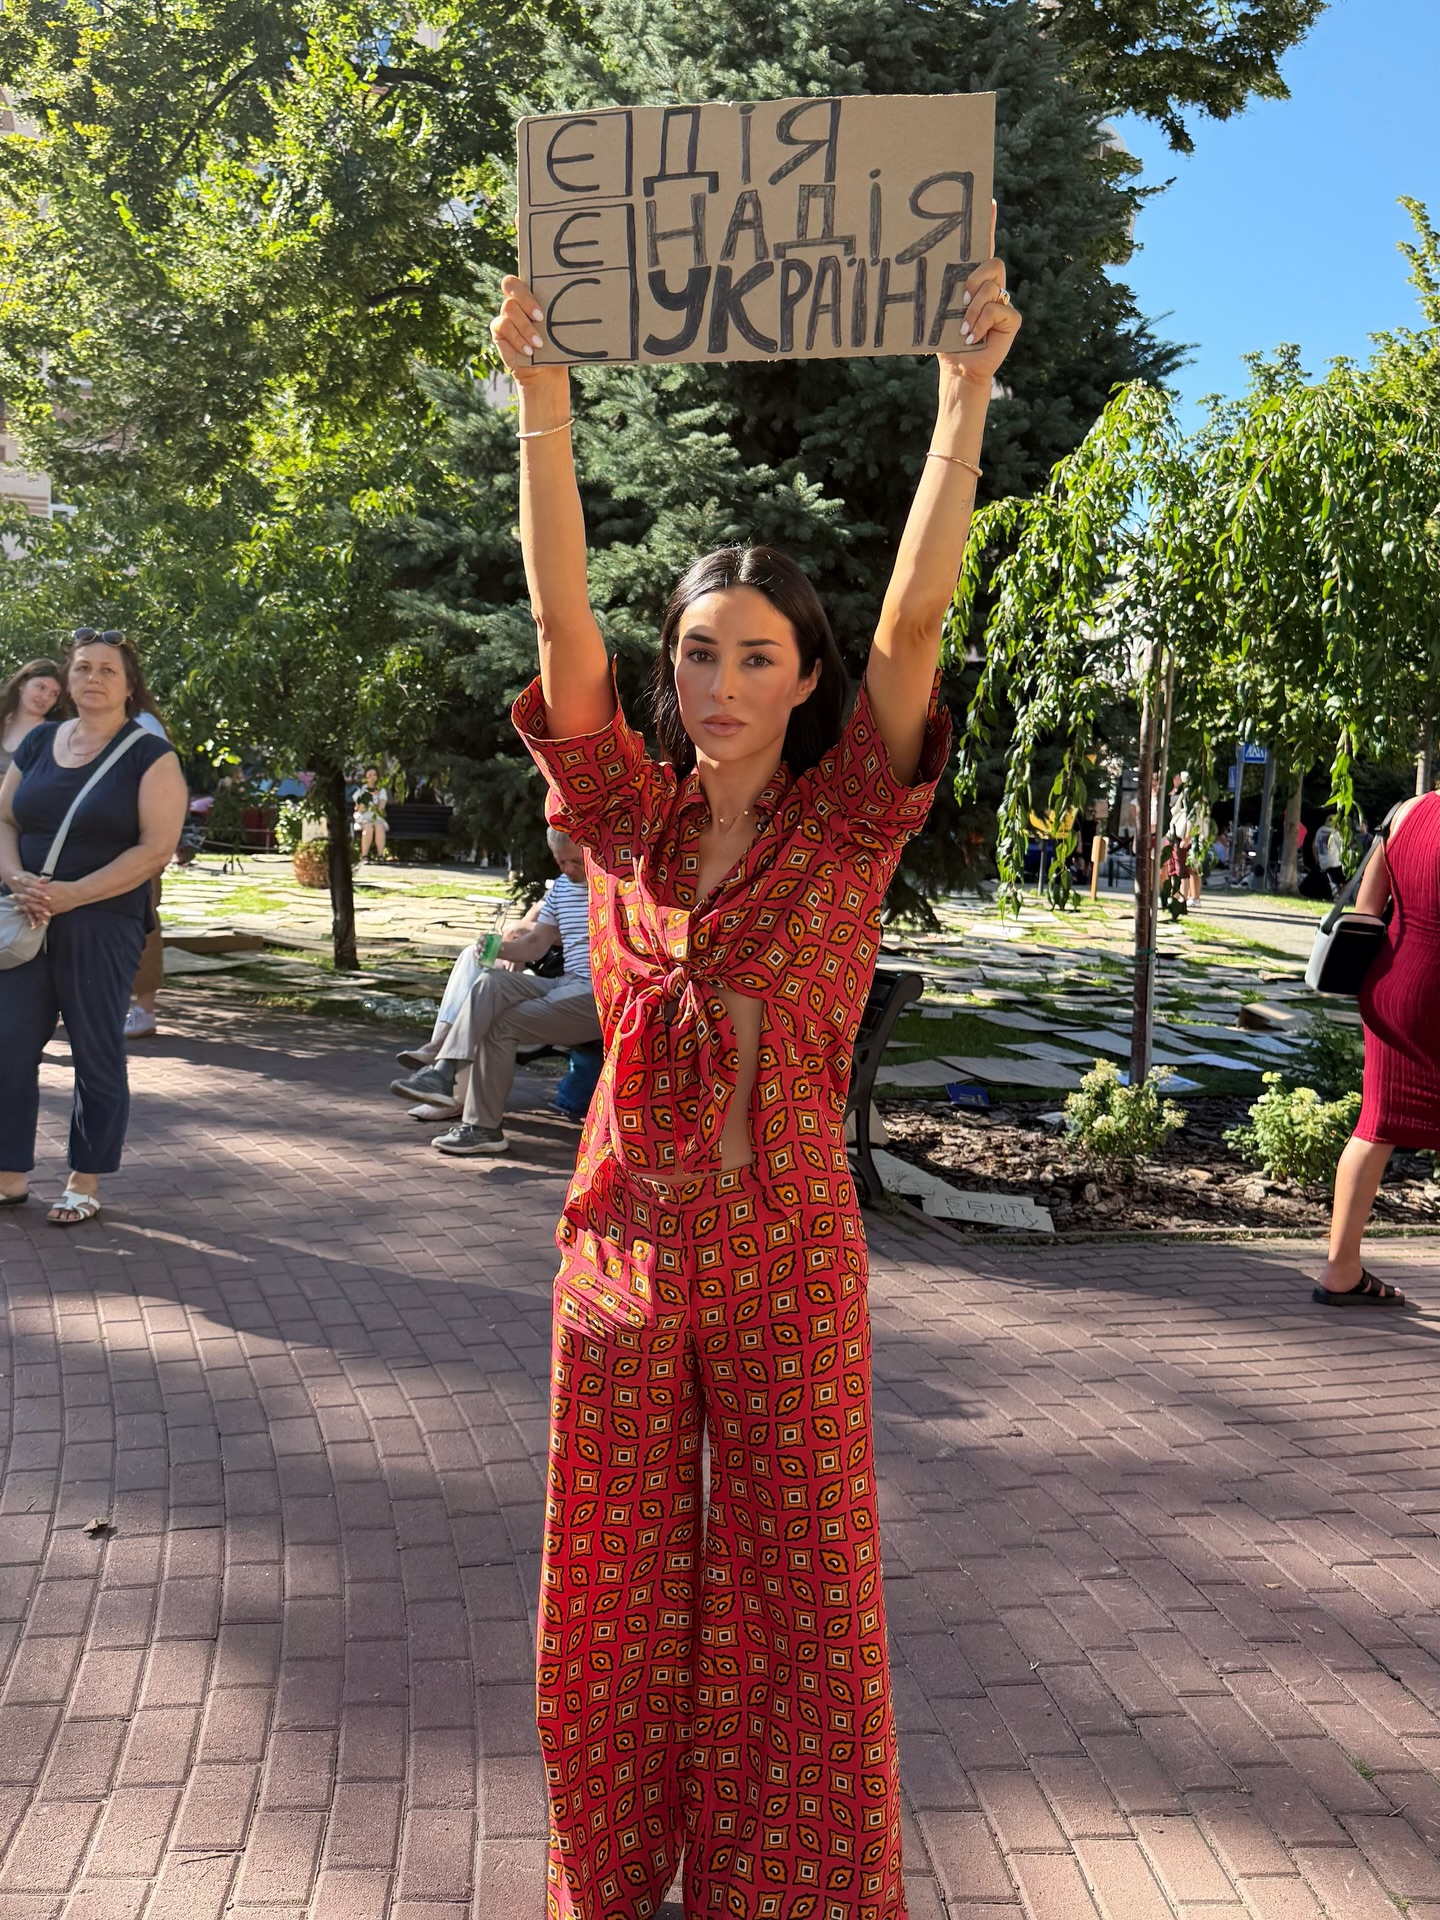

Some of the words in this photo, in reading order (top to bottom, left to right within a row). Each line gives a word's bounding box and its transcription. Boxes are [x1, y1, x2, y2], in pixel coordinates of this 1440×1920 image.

[547, 118, 600, 192] Є
[553, 212, 603, 268] Є
[547, 278, 608, 358] Є
